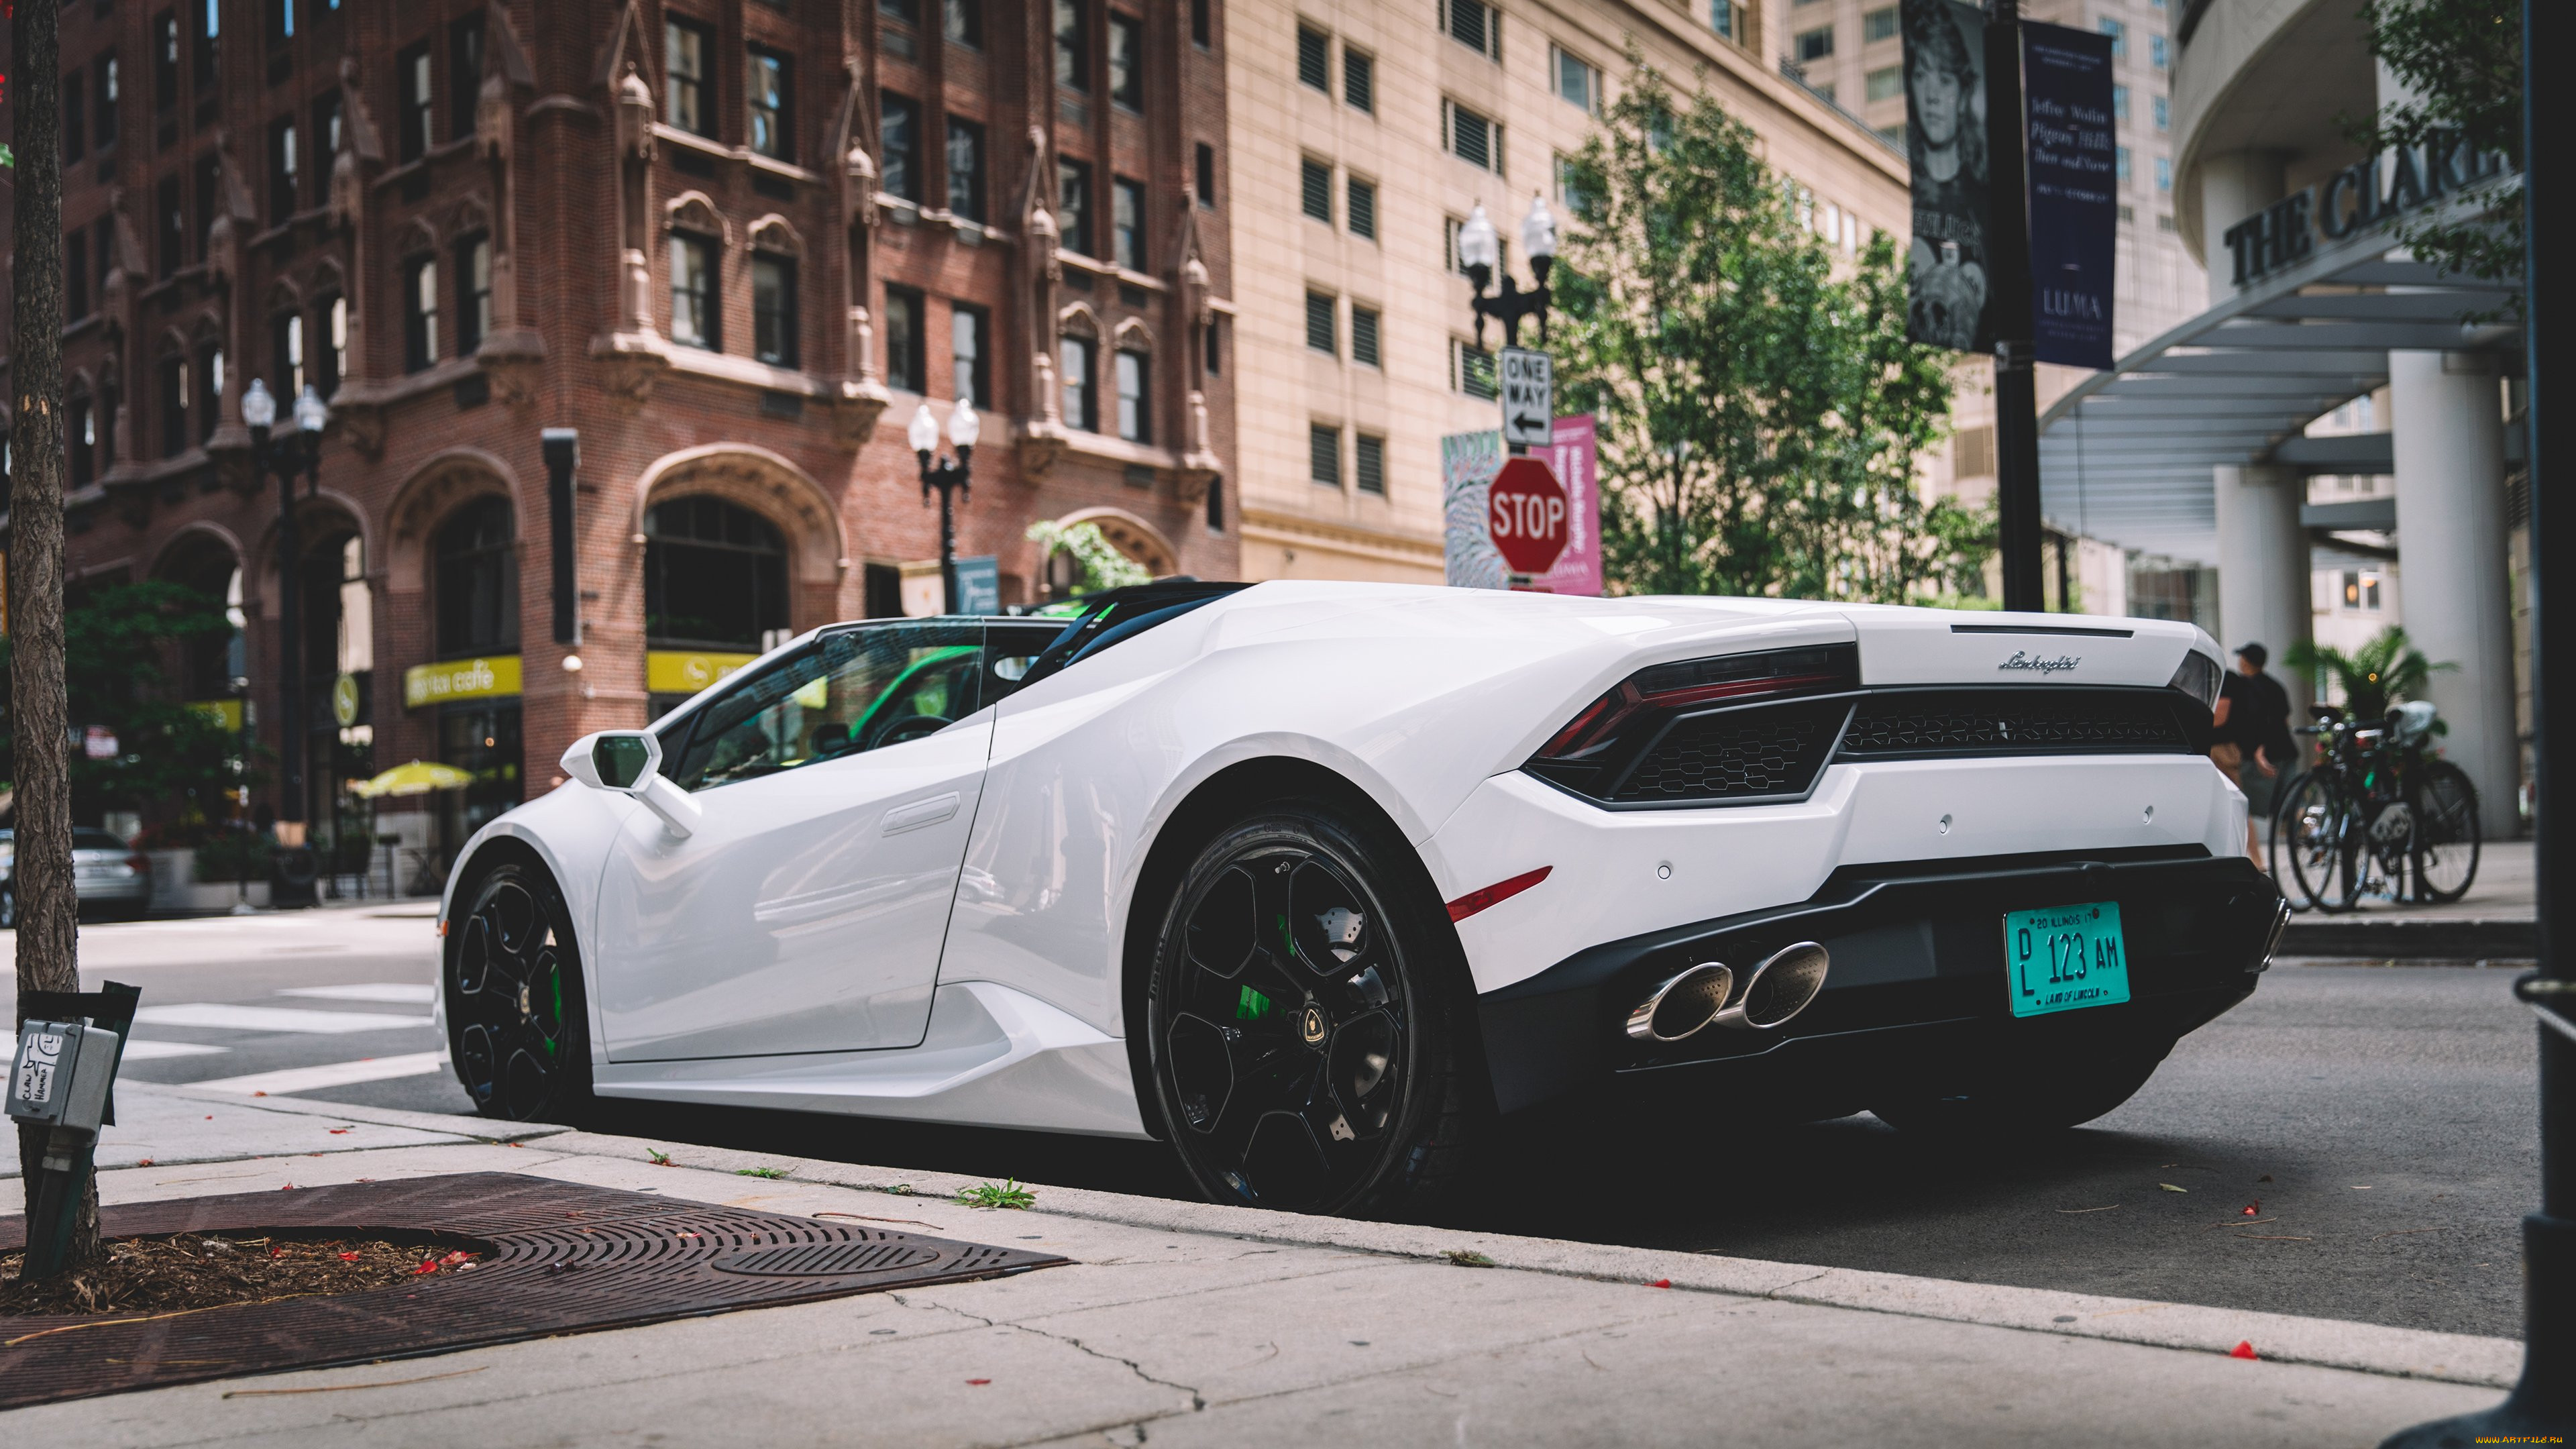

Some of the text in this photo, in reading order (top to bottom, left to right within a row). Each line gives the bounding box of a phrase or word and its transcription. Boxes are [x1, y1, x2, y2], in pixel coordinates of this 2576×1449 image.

[2224, 186, 2313, 285] THE
[2043, 287, 2102, 321] LUMA
[1507, 357, 1544, 383] ONE
[1506, 383, 1546, 408] WAY
[1493, 492, 1564, 539] STOP
[1998, 651, 2081, 675] Lamborghini
[2037, 918, 2047, 928] 20
[2051, 916, 2080, 928] ILLINOIS
[2047, 932, 2087, 983] 123
[2094, 936, 2118, 969] AM
[2045, 987, 2100, 1005] LAND OF LINCOLN
[22, 1074, 32, 1100] CLAW
[34, 1069, 47, 1100] HAMMER
